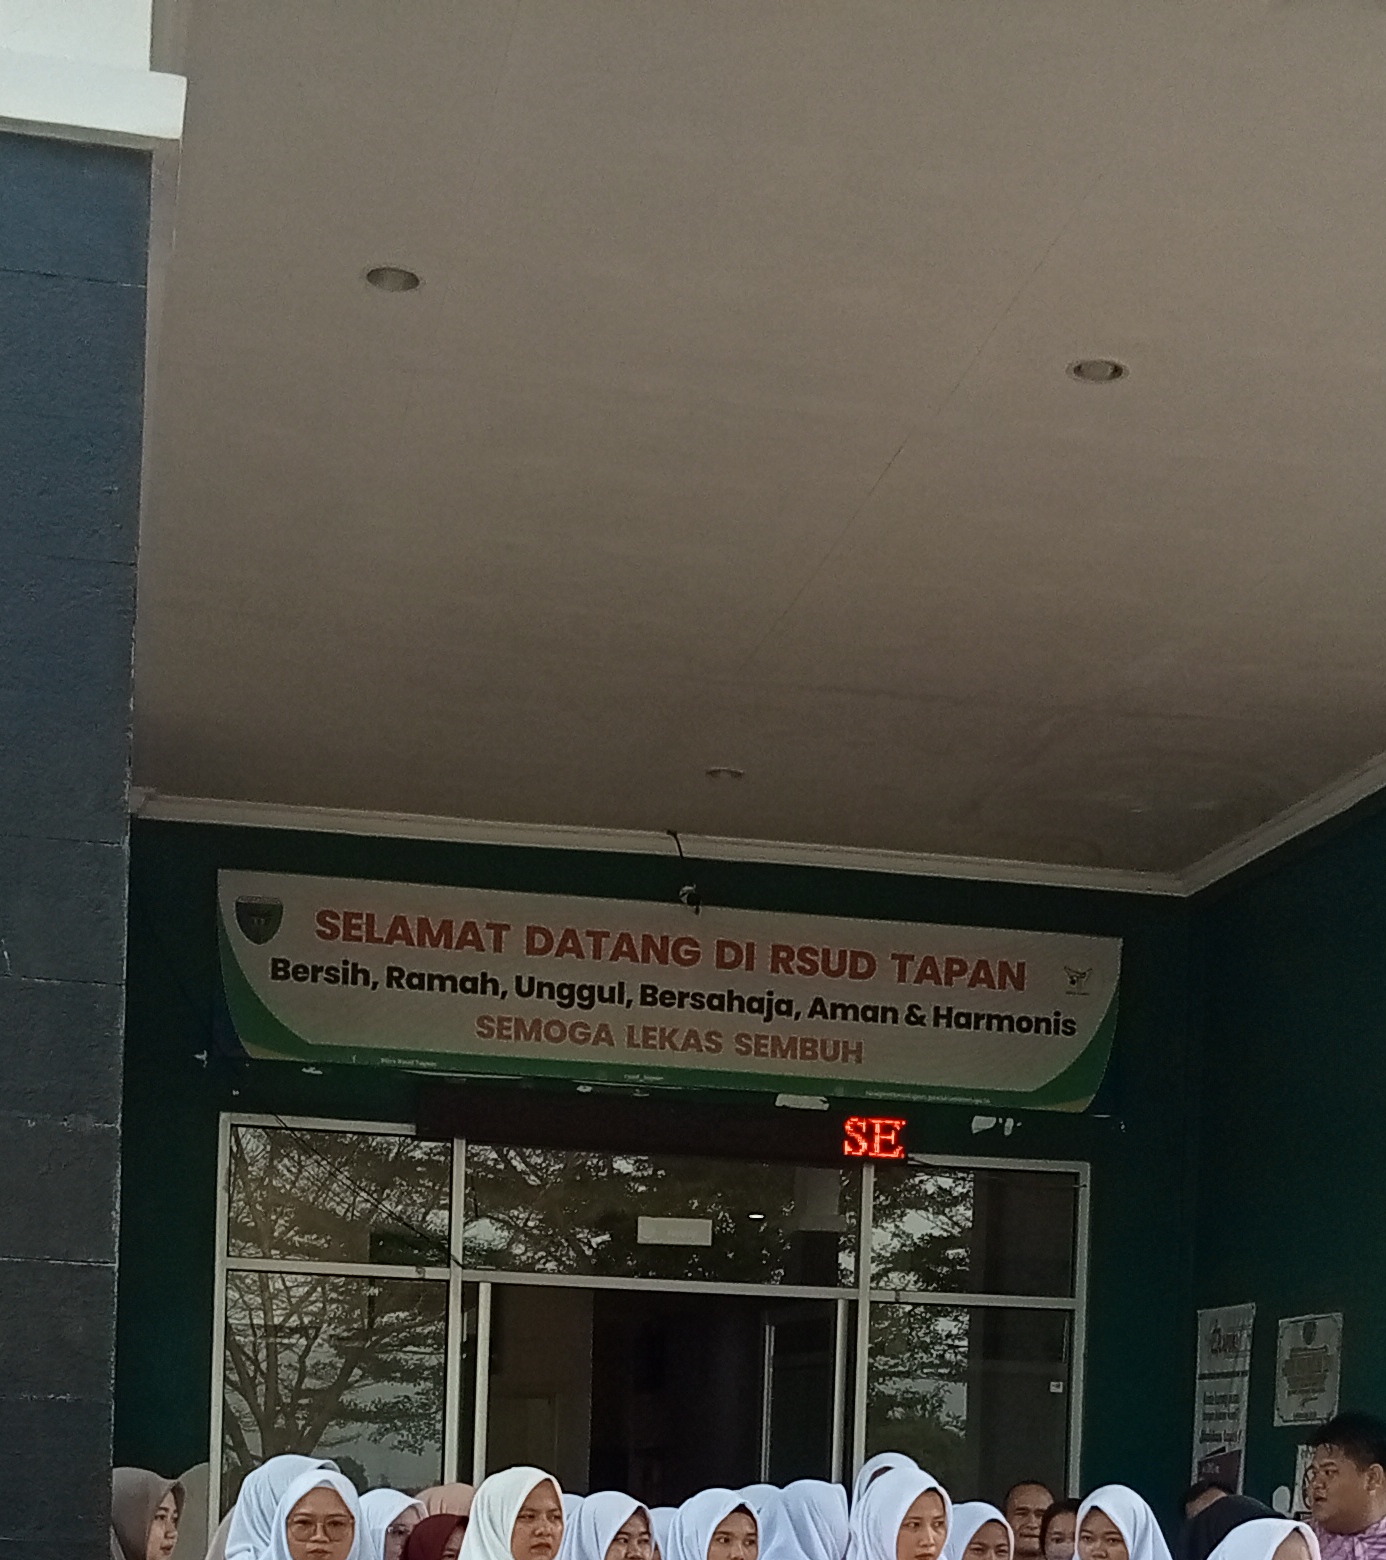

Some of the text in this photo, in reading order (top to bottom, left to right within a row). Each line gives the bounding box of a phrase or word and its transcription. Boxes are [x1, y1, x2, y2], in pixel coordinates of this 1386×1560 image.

[315, 909, 1027, 991] SELAMAT DATANG DI RSUD TAPAN
[269, 956, 1077, 1037] Bersih, Ramah, Unggul, Bersahaja, Aman & Harmonis
[475, 1014, 863, 1065] SEMOGA LEKAS SEMBUH
[843, 1116, 907, 1158] SE
